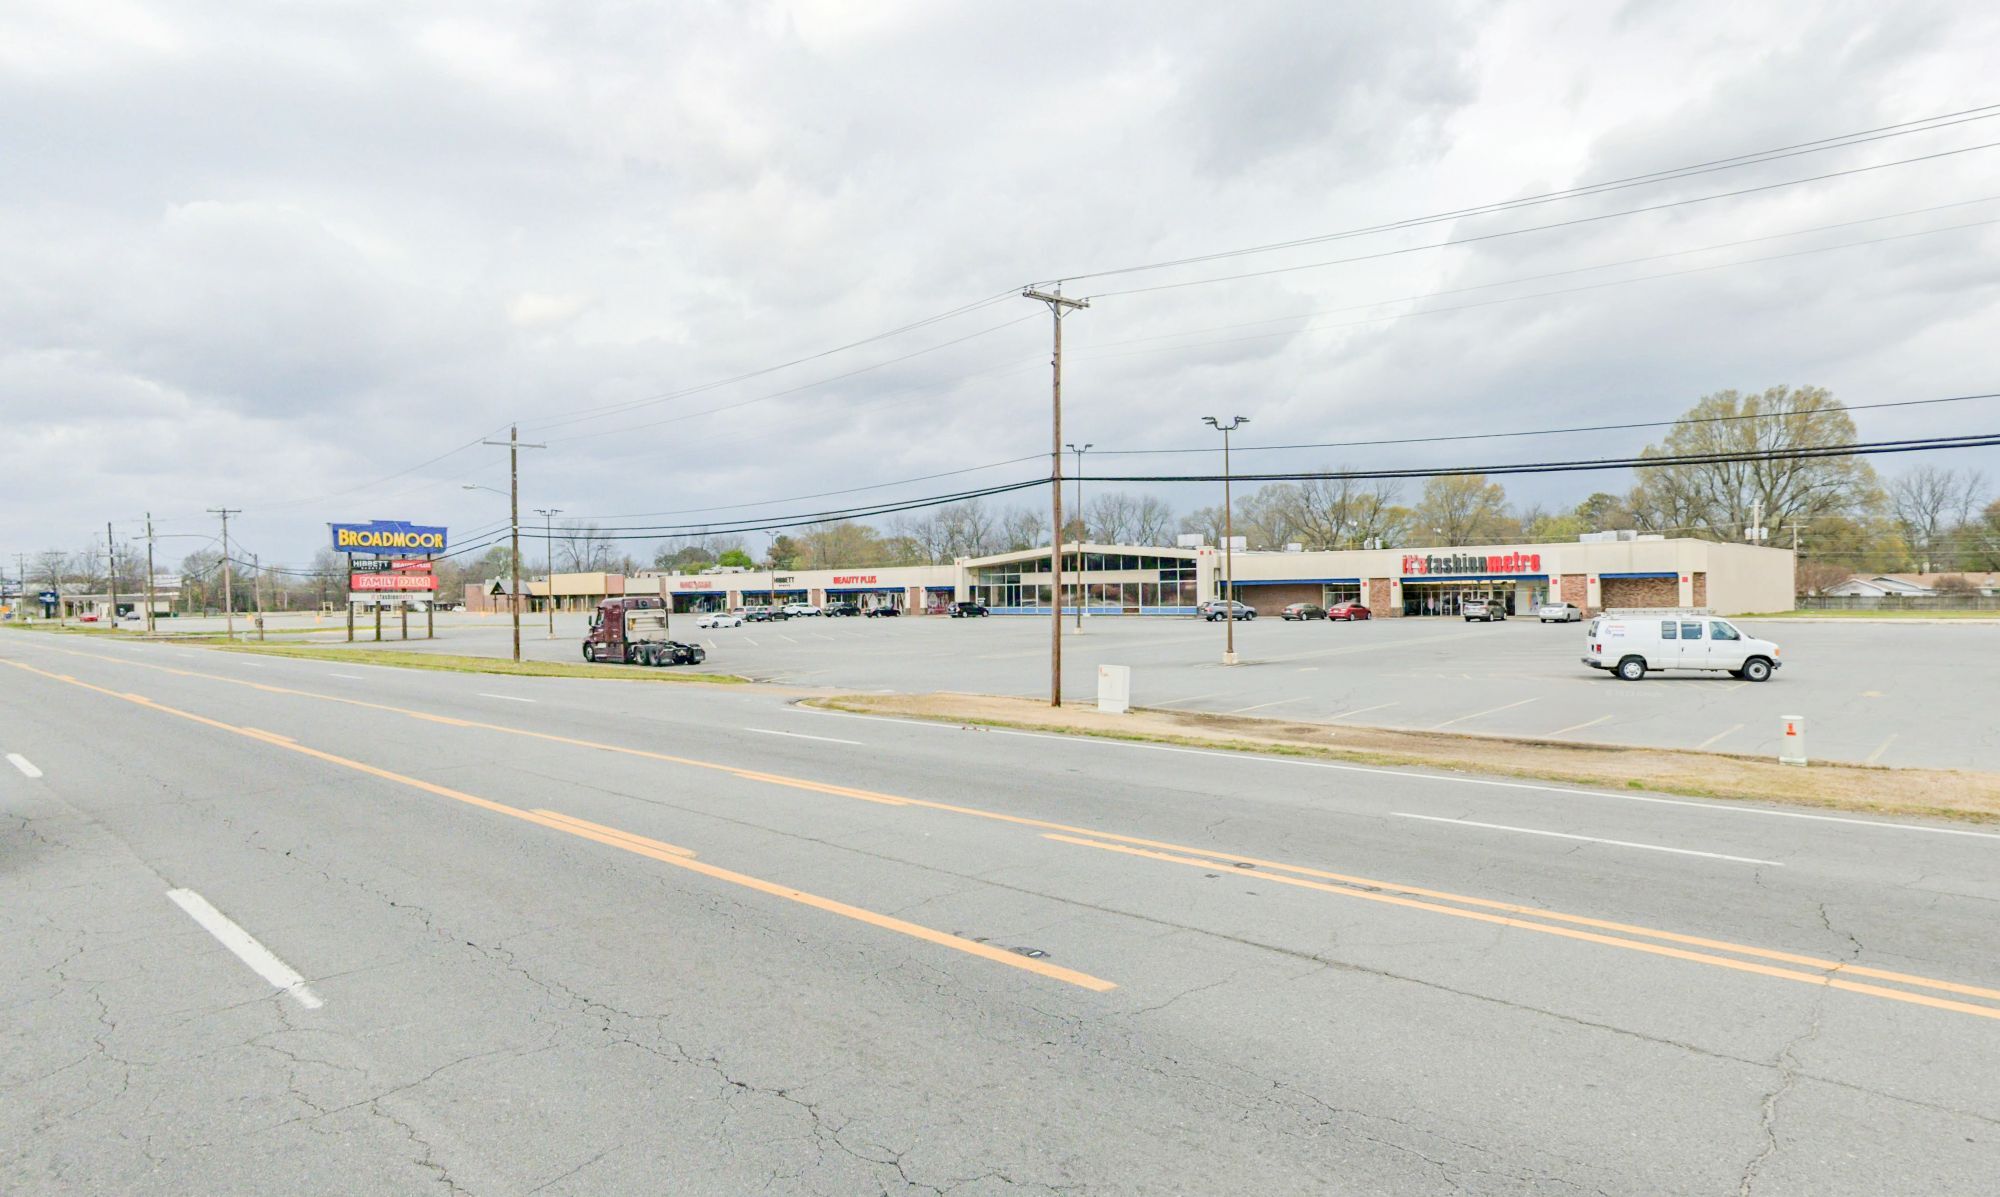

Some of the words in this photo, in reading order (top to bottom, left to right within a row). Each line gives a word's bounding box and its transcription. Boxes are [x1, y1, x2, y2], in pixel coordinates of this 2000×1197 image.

[338, 529, 443, 548] BROADMOOR
[359, 576, 395, 587] FAMILY
[833, 576, 859, 585] BEAUTY
[860, 575, 877, 584] PLUS
